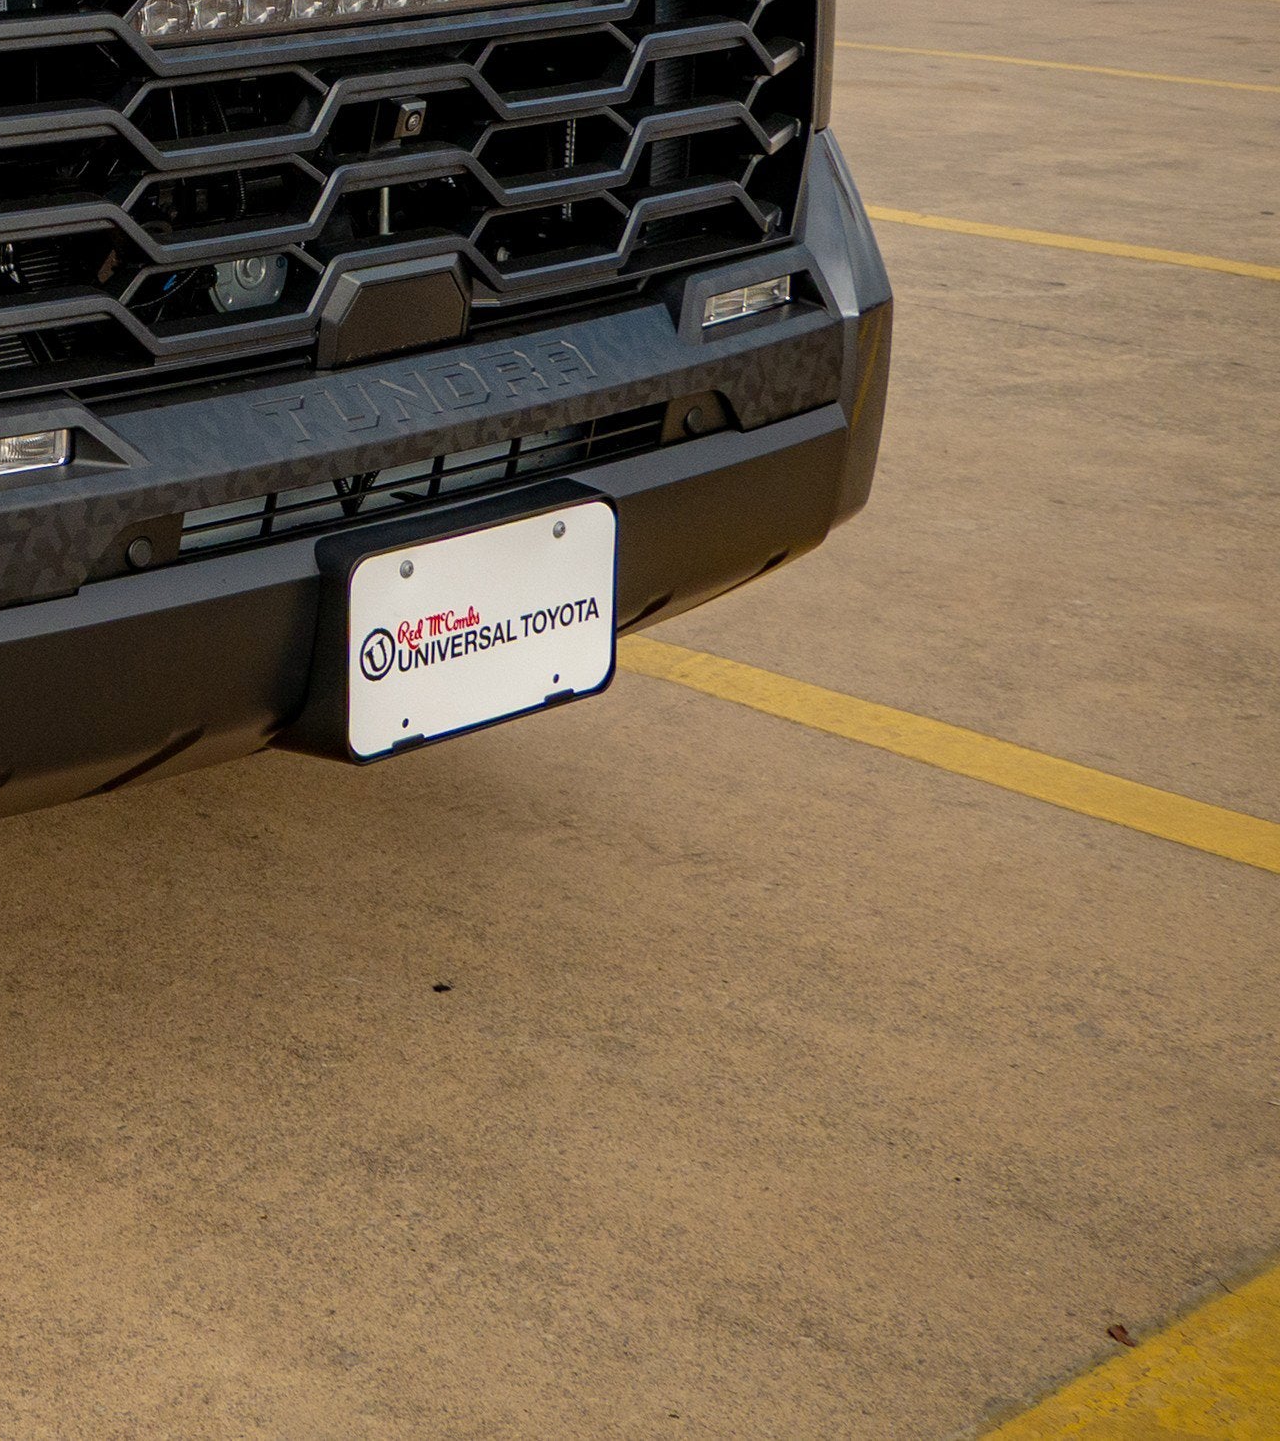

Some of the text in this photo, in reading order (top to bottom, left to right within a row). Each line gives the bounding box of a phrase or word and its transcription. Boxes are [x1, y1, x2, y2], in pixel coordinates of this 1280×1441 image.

[251, 339, 598, 443] TUNDRA
[397, 619, 423, 650] Red
[397, 597, 600, 672] UNIVERSAL TOYOTA
